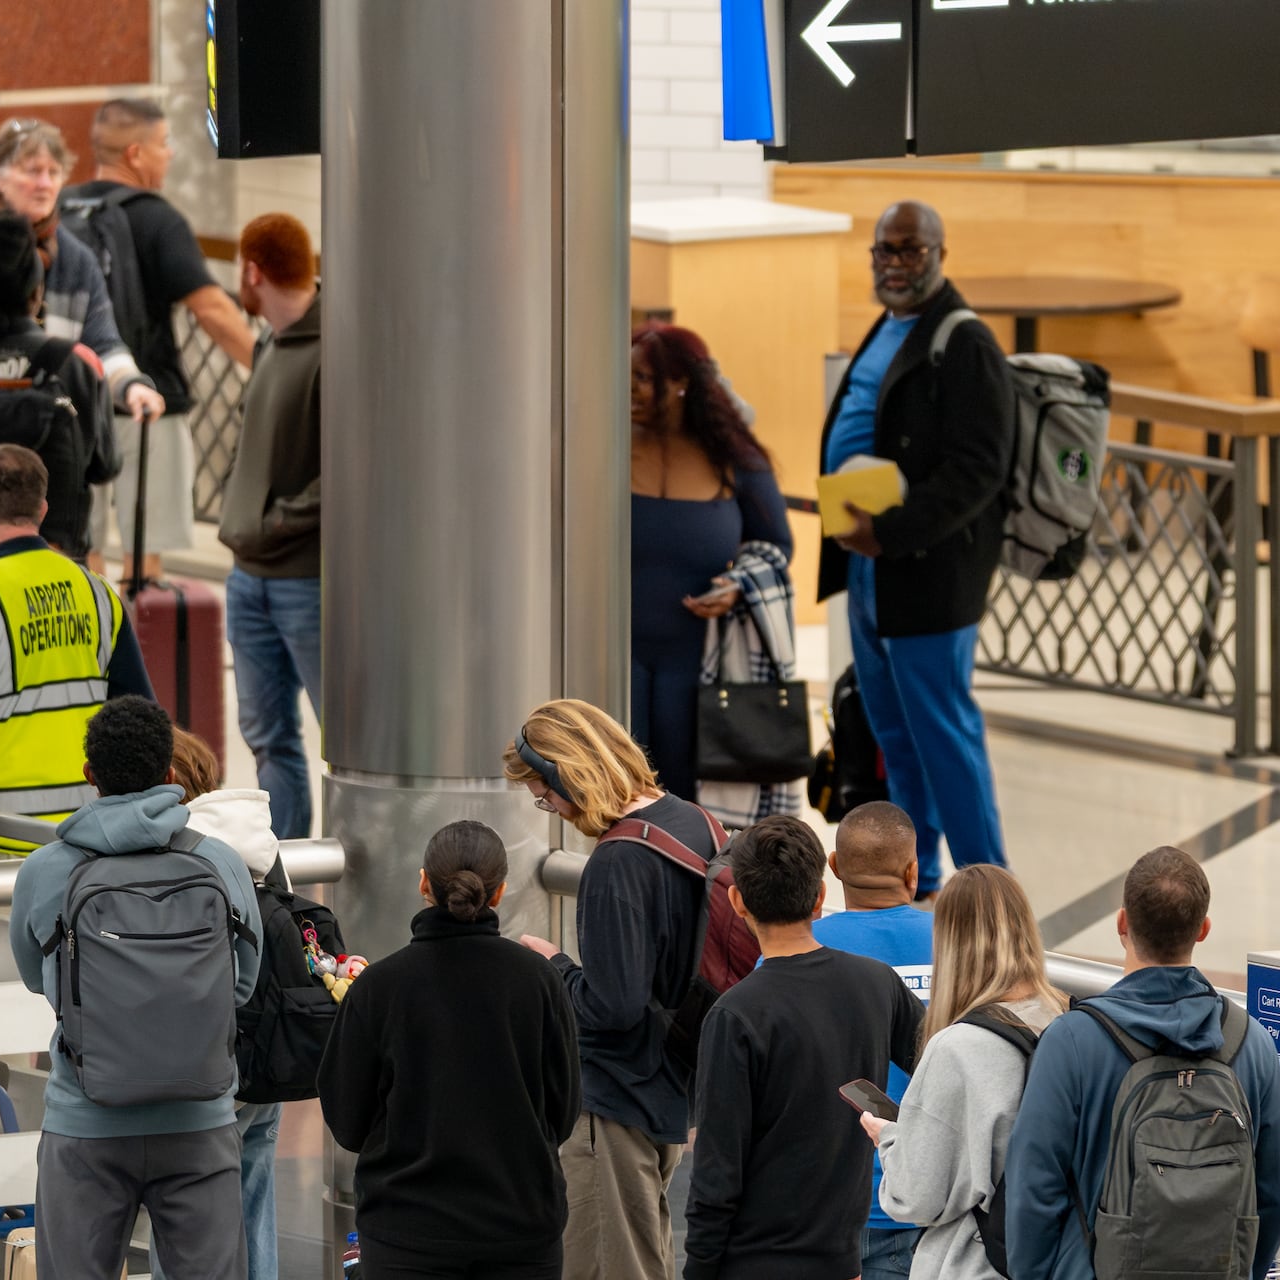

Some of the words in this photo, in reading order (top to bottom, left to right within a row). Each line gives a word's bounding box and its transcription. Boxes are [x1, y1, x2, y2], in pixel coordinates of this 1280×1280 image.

[24, 580, 77, 619] AIRPORT
[20, 614, 92, 656] OPERATIONS
[1261, 995, 1275, 1007] Cart
